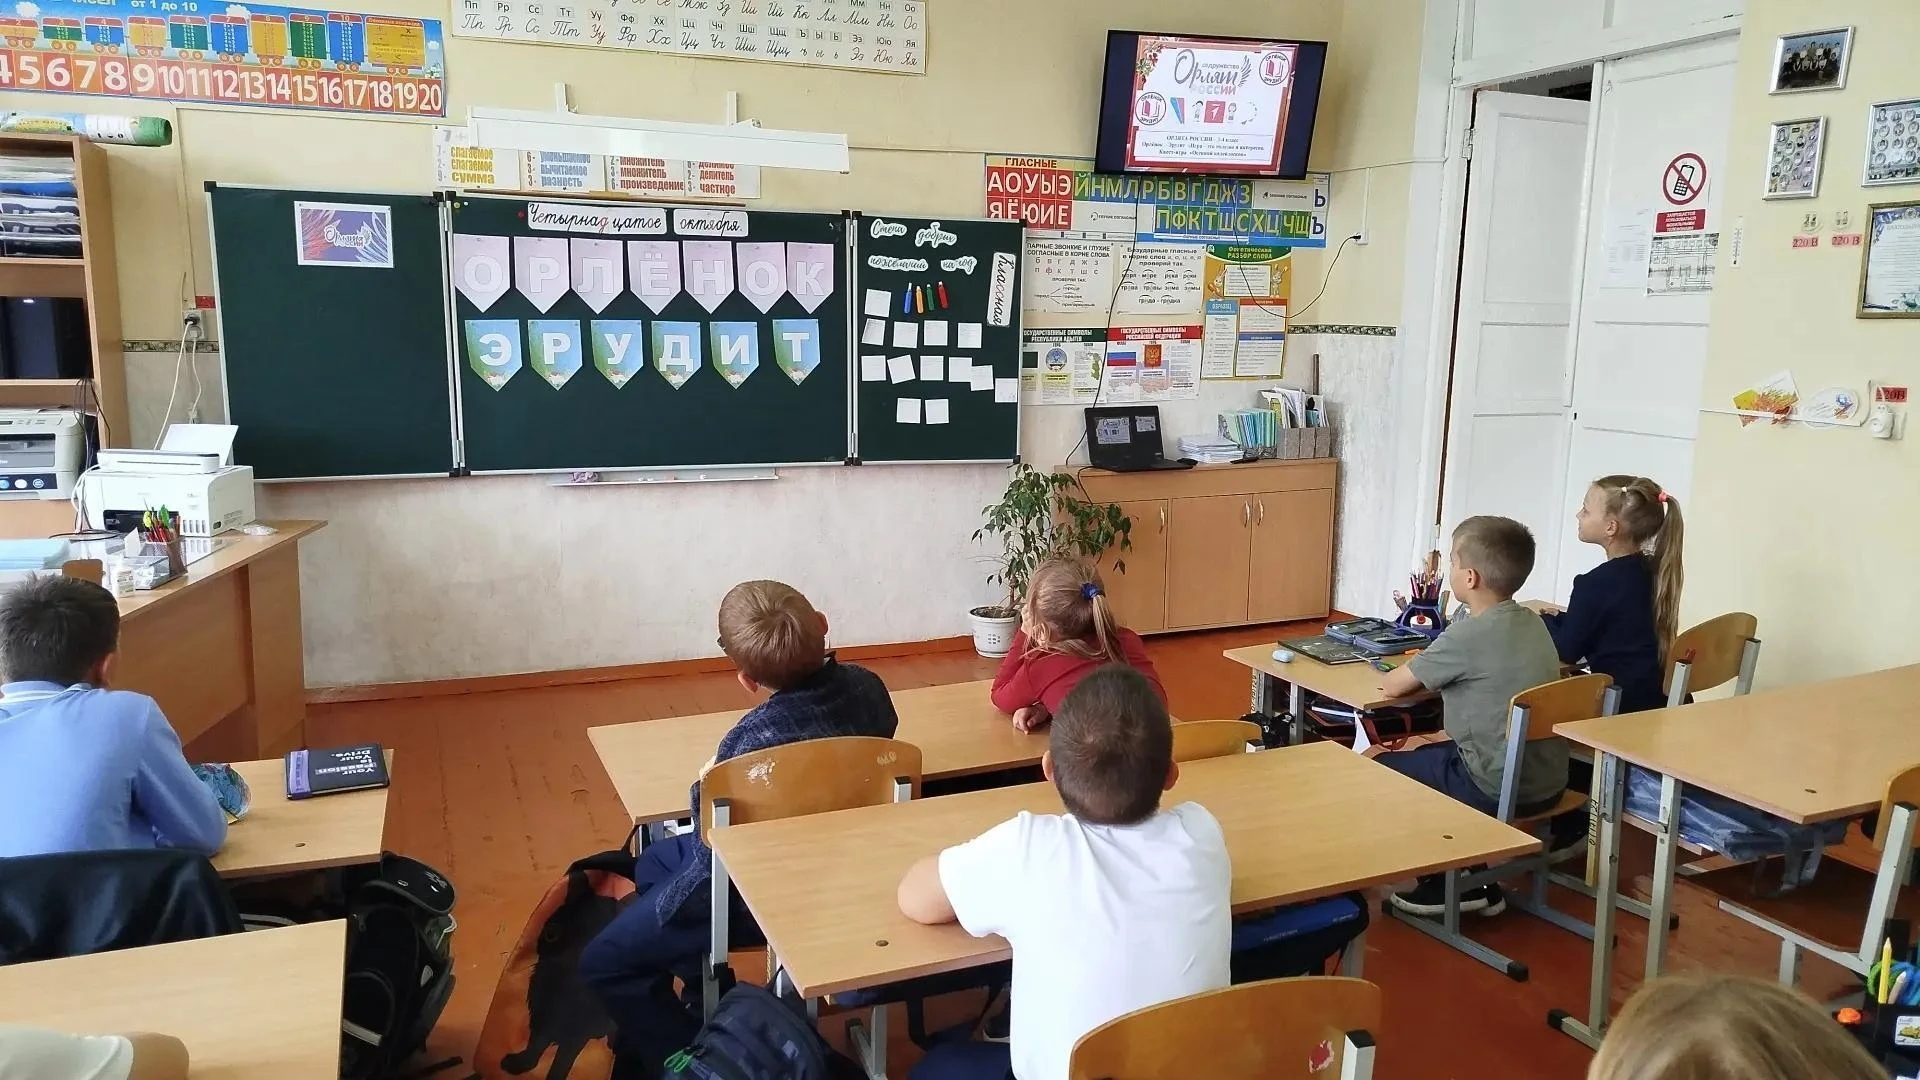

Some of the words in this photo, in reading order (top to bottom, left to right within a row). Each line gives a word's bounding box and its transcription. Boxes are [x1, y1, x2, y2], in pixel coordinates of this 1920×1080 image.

[161, 3, 178, 12] до
[182, 2, 198, 12] 10
[19, 56, 42, 86] 5
[46, 58, 71, 87] 6
[74, 60, 98, 89] 7
[103, 62, 128, 91] 8
[132, 63, 156, 92] 9
[157, 65, 185, 95] 10
[186, 67, 212, 96] 11
[213, 69, 240, 98] 12
[240, 70, 266, 99] 13
[266, 72, 293, 101] 14
[292, 74, 318, 103] 15
[318, 76, 344, 104] 16
[343, 78, 368, 106] 17
[368, 80, 393, 109] 18
[393, 82, 418, 110] 19
[418, 83, 442, 111] 20
[1190, 84, 1237, 96] ОССИИ
[450, 146, 494, 160] слагаемое
[451, 159, 494, 173] слагаемое
[1005, 157, 1058, 169] ГЛАСНЫЕ
[540, 164, 589, 177] вычитаемое
[620, 166, 667, 179] множитель
[699, 169, 735, 181] делитель
[451, 171, 495, 185] сумма
[541, 176, 583, 188] разность
[620, 178, 685, 192] произведение
[699, 183, 736, 195] частное
[1026, 242, 1053, 251] ПАРНЫЕ
[1055, 243, 1081, 251] ЗВОНКИЕ
[1088, 244, 1111, 252] ГЛУХИЕ
[1792, 238, 1809, 248] 220
[1831, 236, 1850, 246] 220
[1026, 249, 1064, 257] СОГЛАСНЫЕ
[1070, 250, 1090, 258] КОРНЕ
[992, 254, 1015, 326] Классная
[478, 331, 811, 373] ЭРУДИТ
